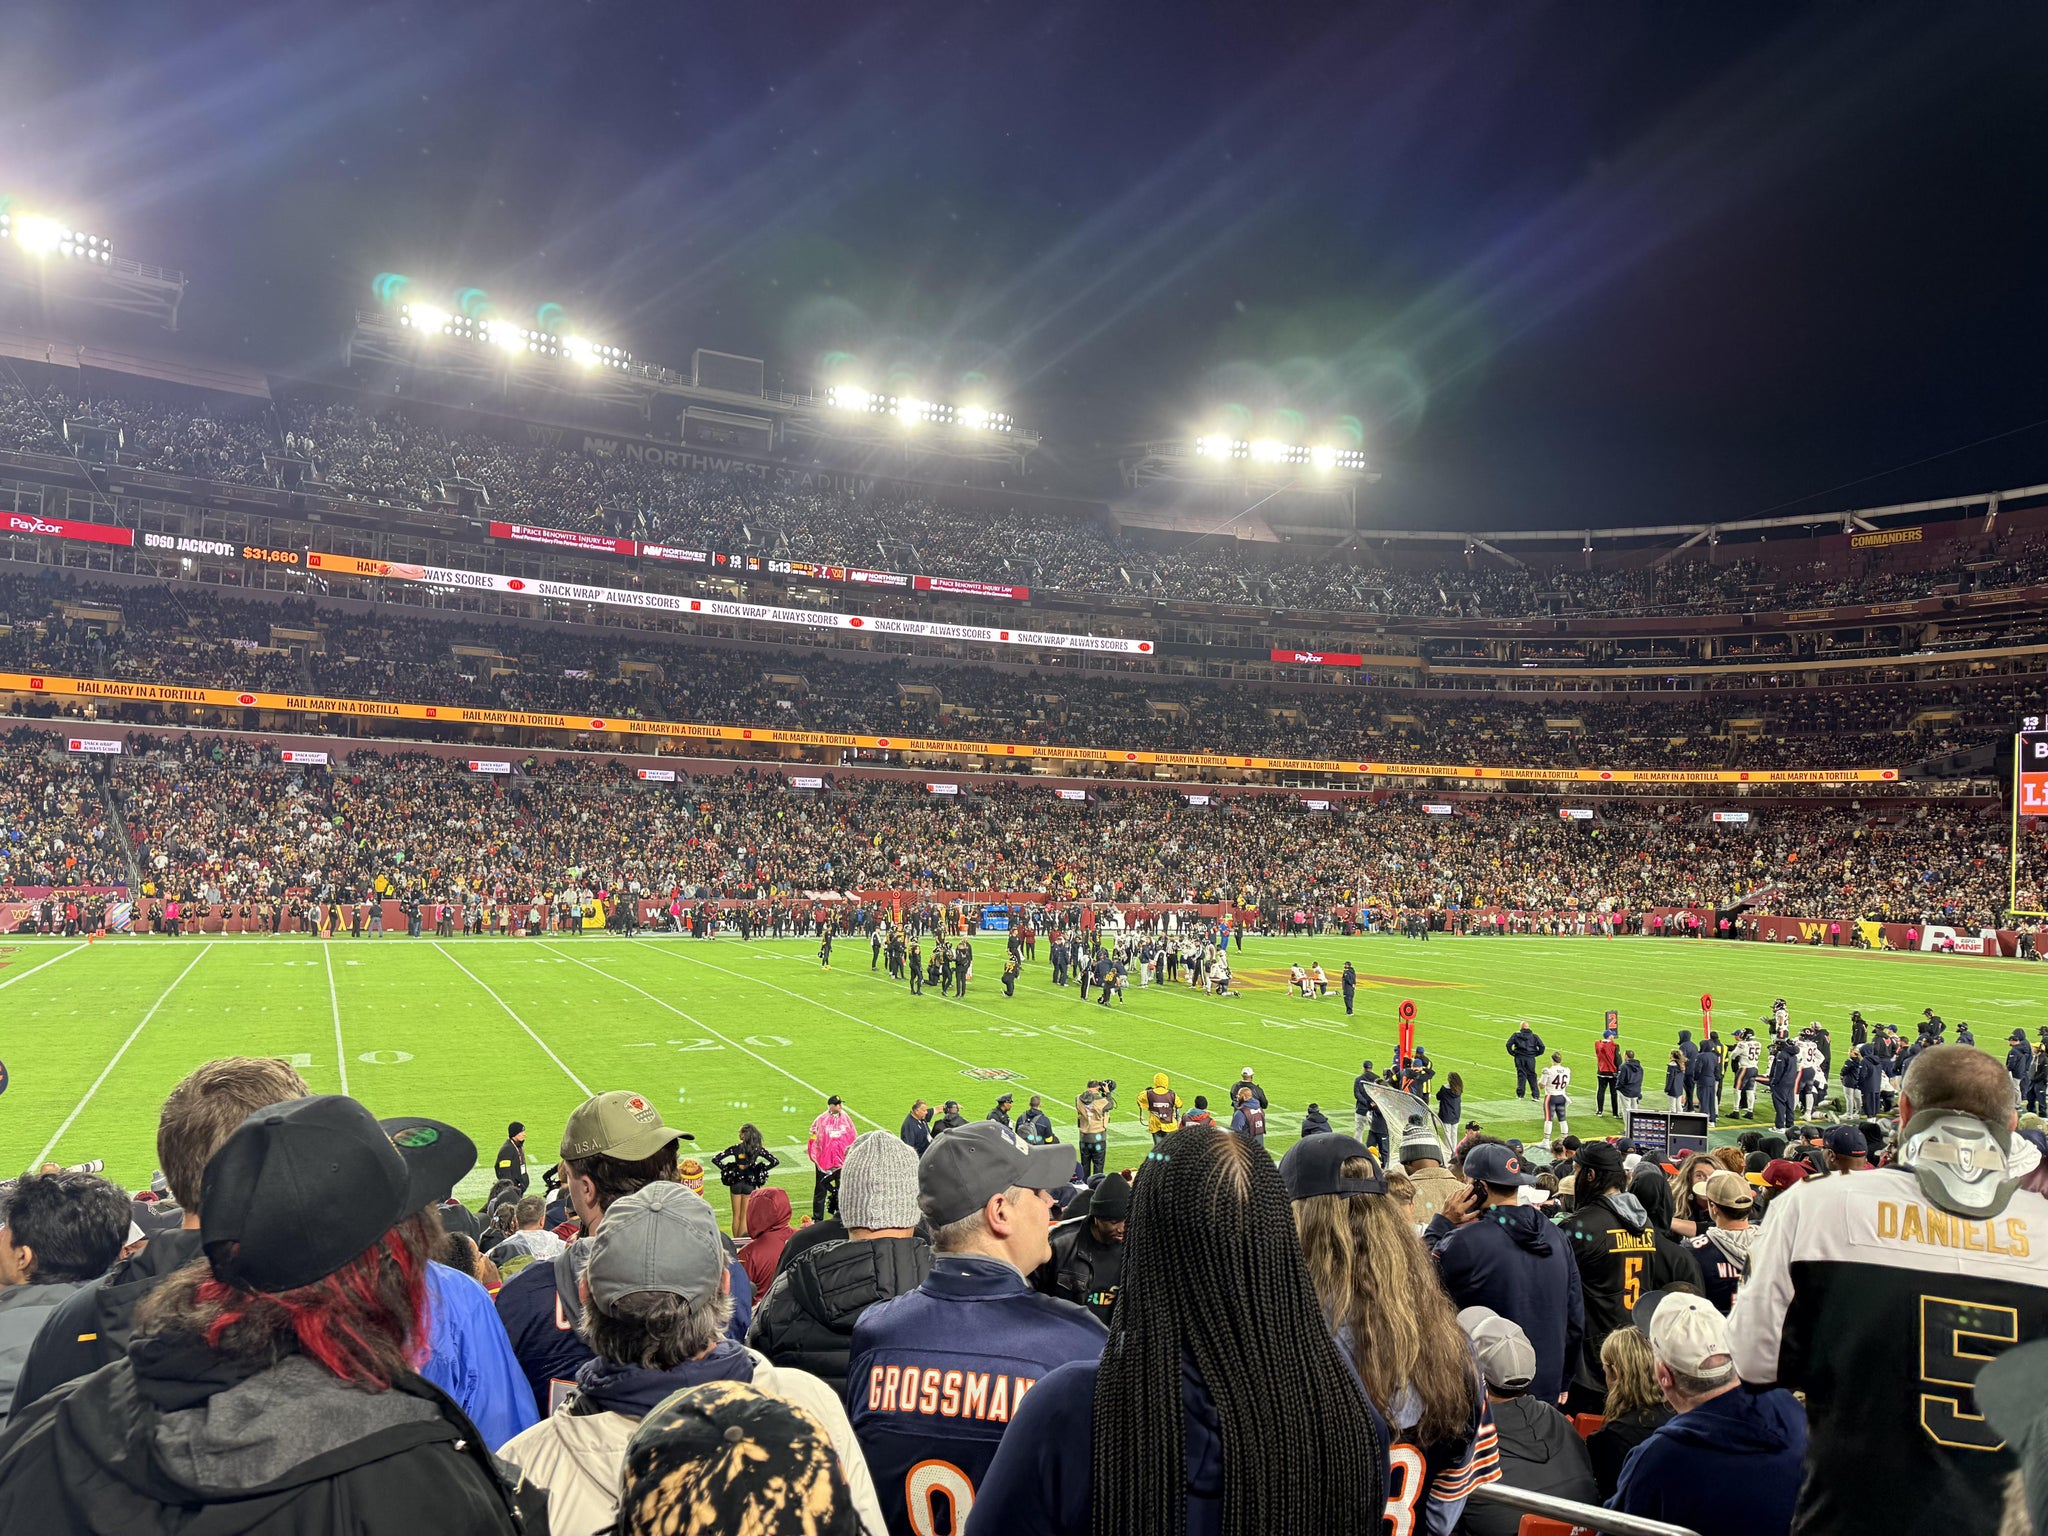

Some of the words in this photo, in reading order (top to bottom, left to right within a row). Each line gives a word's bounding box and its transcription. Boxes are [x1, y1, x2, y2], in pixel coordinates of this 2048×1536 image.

[10, 516, 63, 533] Paycor
[542, 530, 577, 541] BENOWITZ
[578, 535, 601, 544] INJURY
[602, 538, 616, 546] LAW
[1851, 530, 1923, 547] COMMANDERS
[176, 537, 235, 557] JACKPOT:
[243, 546, 299, 564] $31,660
[663, 547, 707, 559] NORTHWEST
[730, 555, 741, 565] 13
[768, 560, 791, 574] 5:13
[821, 566, 828, 575] 7
[868, 573, 908, 583] NORTHWEST
[455, 572, 494, 587] SCORES
[539, 583, 571, 597] SNACK
[573, 586, 600, 599] WRAP
[607, 592, 644, 605] ALWAYS
[646, 595, 680, 608] SCORES
[711, 603, 740, 615] SNACK
[742, 606, 767, 618] WRAP
[772, 610, 805, 623] ALWAYS
[807, 613, 838, 625] SCORES
[875, 620, 901, 631] SNACK
[902, 624, 925, 634] WRAP
[930, 626, 961, 637] ALWAYS
[962, 629, 991, 639] SCORES
[1018, 633, 1043, 643] SNACK
[1043, 635, 1066, 646] WRAP
[1069, 638, 1099, 648] ALWAYS
[1100, 640, 1129, 650] SCORES
[1294, 652, 1323, 663] Paycor
[77, 682, 101, 693] HAIL
[104, 684, 133, 695] MARY
[136, 686, 147, 697] IN
[149, 687, 156, 697] A
[160, 688, 205, 700] TORTILLA
[287, 698, 308, 708] HAIL
[310, 700, 336, 710] MARY
[338, 701, 348, 711] IN
[350, 703, 356, 712] A
[358, 703, 399, 715] TORTILLA
[463, 711, 482, 720] HAIL
[483, 712, 507, 722] MARY
[510, 713, 518, 722] IN
[520, 714, 526, 723] A
[527, 715, 565, 726] TORTILLA
[2023, 716, 2039, 726] 13
[630, 722, 649, 731] HAIL
[650, 724, 670, 733] MARY
[672, 725, 680, 733] IN
[681, 726, 686, 734] A
[688, 727, 721, 736] TORTILLA
[773, 732, 788, 741] HAIL
[790, 733, 809, 742] MARY
[811, 734, 818, 743] IN
[819, 735, 825, 743] A
[826, 735, 856, 745] TORTILLA
[911, 740, 925, 749] HAIL
[926, 741, 944, 750] MARY
[945, 742, 952, 750] IN
[953, 743, 958, 751] A
[960, 743, 988, 752] TORTILLA
[1033, 747, 1047, 755] HAIL
[1048, 748, 1065, 756] MARY
[1066, 749, 1073, 757] IN
[1079, 750, 1107, 759] TORTILLA
[1170, 755, 1187, 763] MARY
[1188, 756, 1195, 764] IN
[1200, 757, 1227, 765] TORTILLA
[1269, 760, 1282, 768] HAIL
[1300, 761, 1307, 769] IN
[1313, 762, 1340, 770] TORTILLA
[1387, 765, 1400, 773] HAIL
[1418, 766, 1425, 774] IN
[1431, 767, 1457, 775] TORTILLA
[1516, 770, 1533, 778] MARY
[1548, 771, 1578, 779] TORTILLA
[1809, 772, 1817, 780] IN
[1819, 772, 1824, 780] A
[1825, 772, 1858, 780] TORTILLA
[1955, 943, 1982, 951] MNF
[1608, 1013, 1617, 1029] 2
[666, 1035, 793, 1052] 20
[1551, 1074, 1569, 1089] 46
[574, 1138, 601, 1154] U.S.A.
[1877, 1200, 2029, 1257] DANIELS
[1615, 1232, 1653, 1249] DANIELS
[1624, 1257, 1643, 1310] 5
[1920, 1294, 2018, 1451] 5
